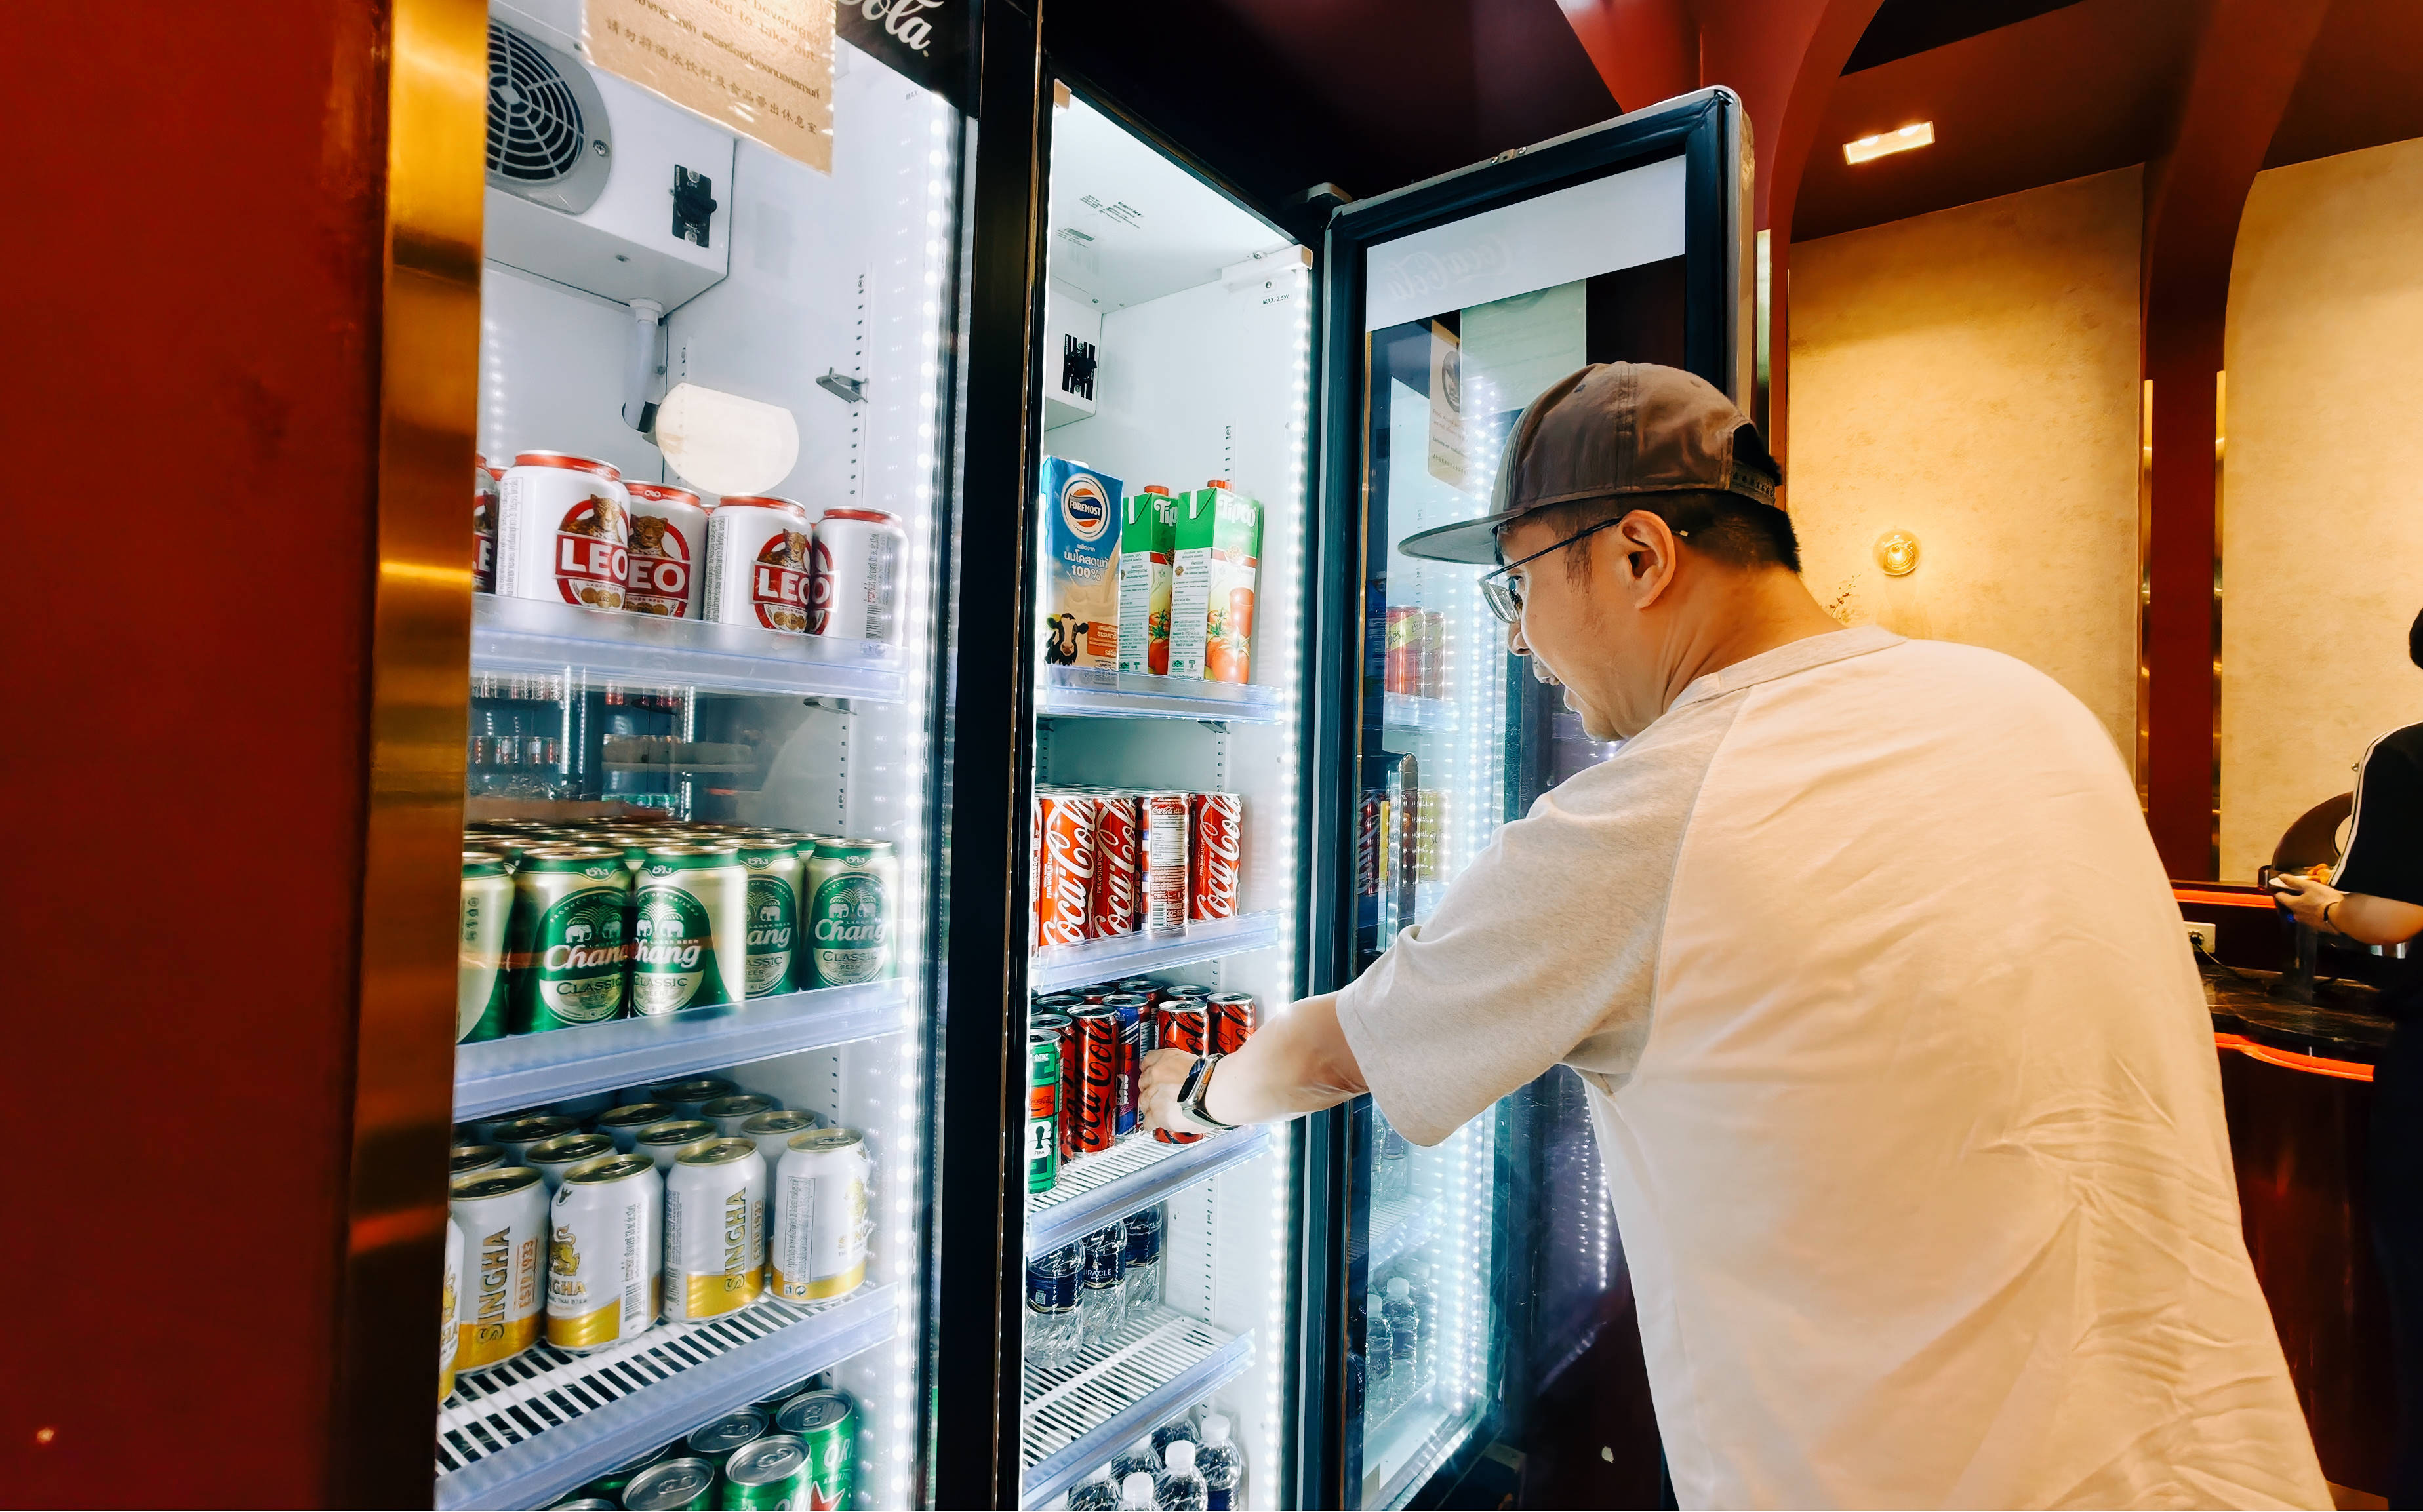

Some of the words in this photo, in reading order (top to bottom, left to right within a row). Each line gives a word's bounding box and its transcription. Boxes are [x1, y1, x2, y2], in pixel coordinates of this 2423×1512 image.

[740, 10, 753, 26] to
[759, 22, 788, 47] take
[1070, 500, 1102, 516] FOREMOST
[1154, 498, 1178, 527] Tip
[561, 538, 628, 581] LEO
[1071, 565, 1102, 582] 100%
[628, 559, 686, 593] EO
[758, 568, 811, 605] LEO
[746, 926, 791, 948] ang
[814, 918, 887, 944] Chang
[746, 956, 783, 967] ASSIC
[723, 1187, 746, 1292] SINGHA
[476, 1225, 510, 1343] SINGHA
